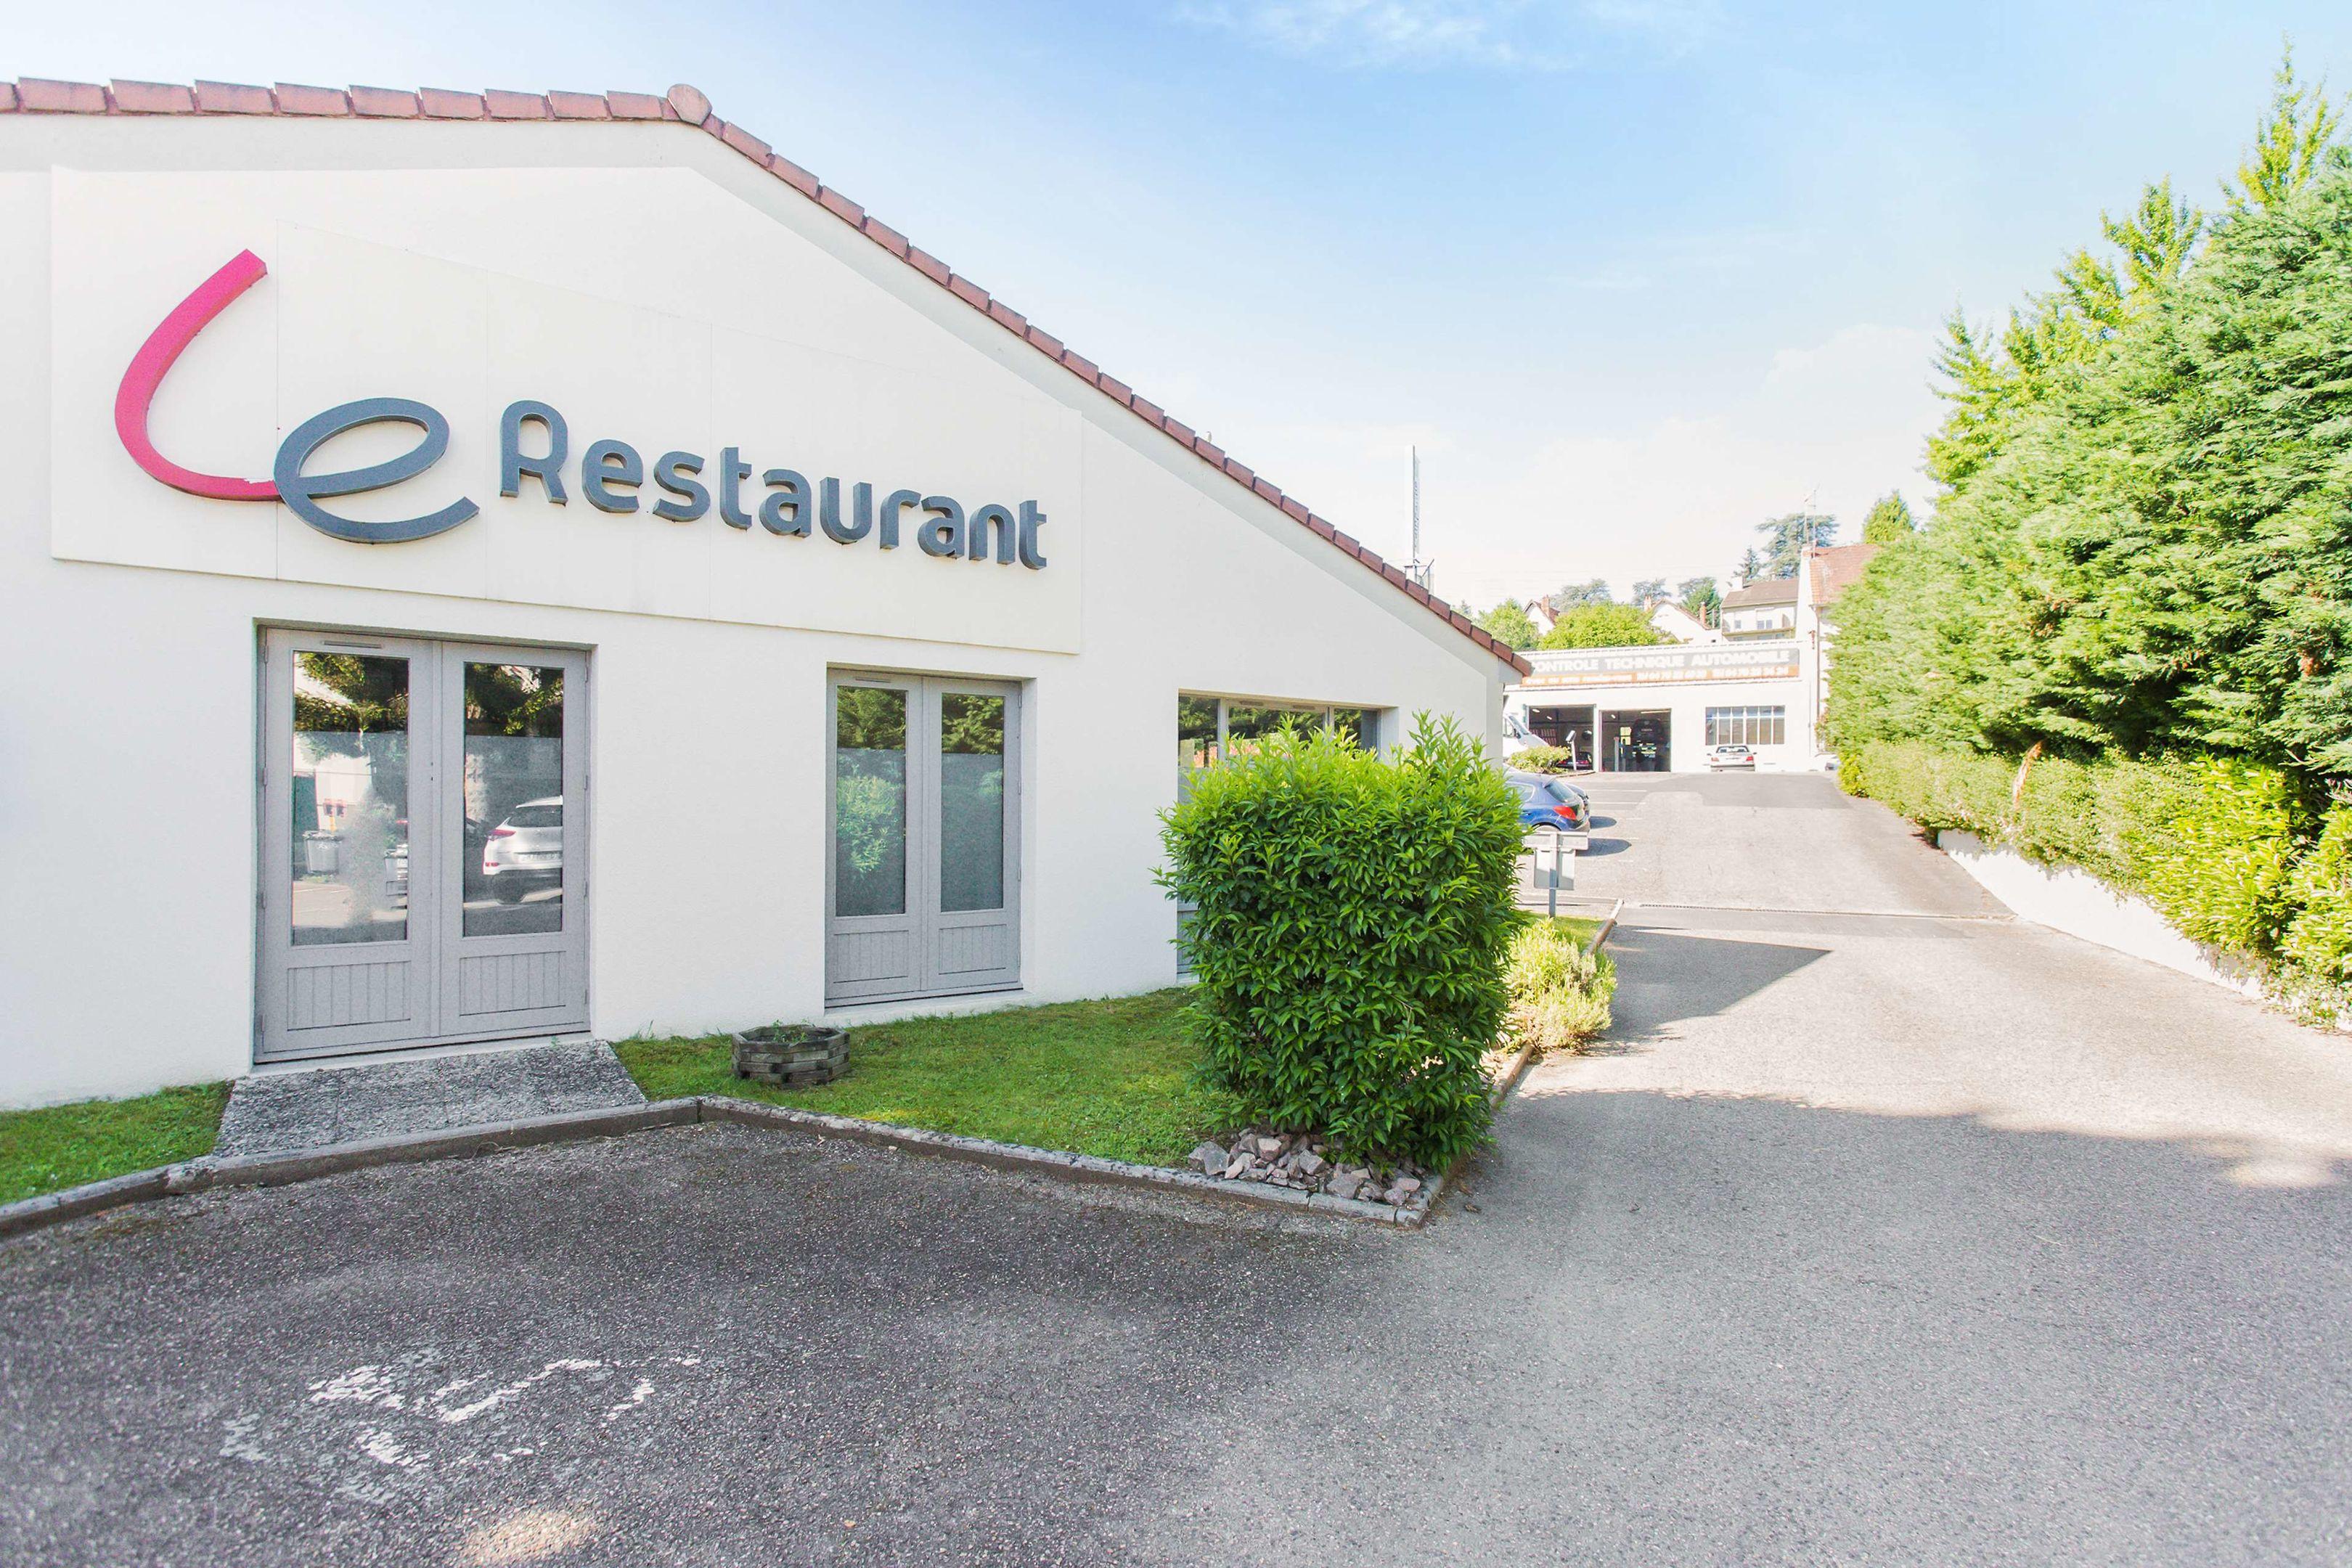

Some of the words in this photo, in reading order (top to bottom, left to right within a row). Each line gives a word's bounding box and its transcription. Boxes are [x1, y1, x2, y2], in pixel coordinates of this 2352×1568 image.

[115, 250, 479, 544] Le
[499, 400, 1047, 570] Restaurant
[1605, 654, 1685, 671] TECHNIQUE
[1691, 650, 1789, 667] AUTOMOBILE
